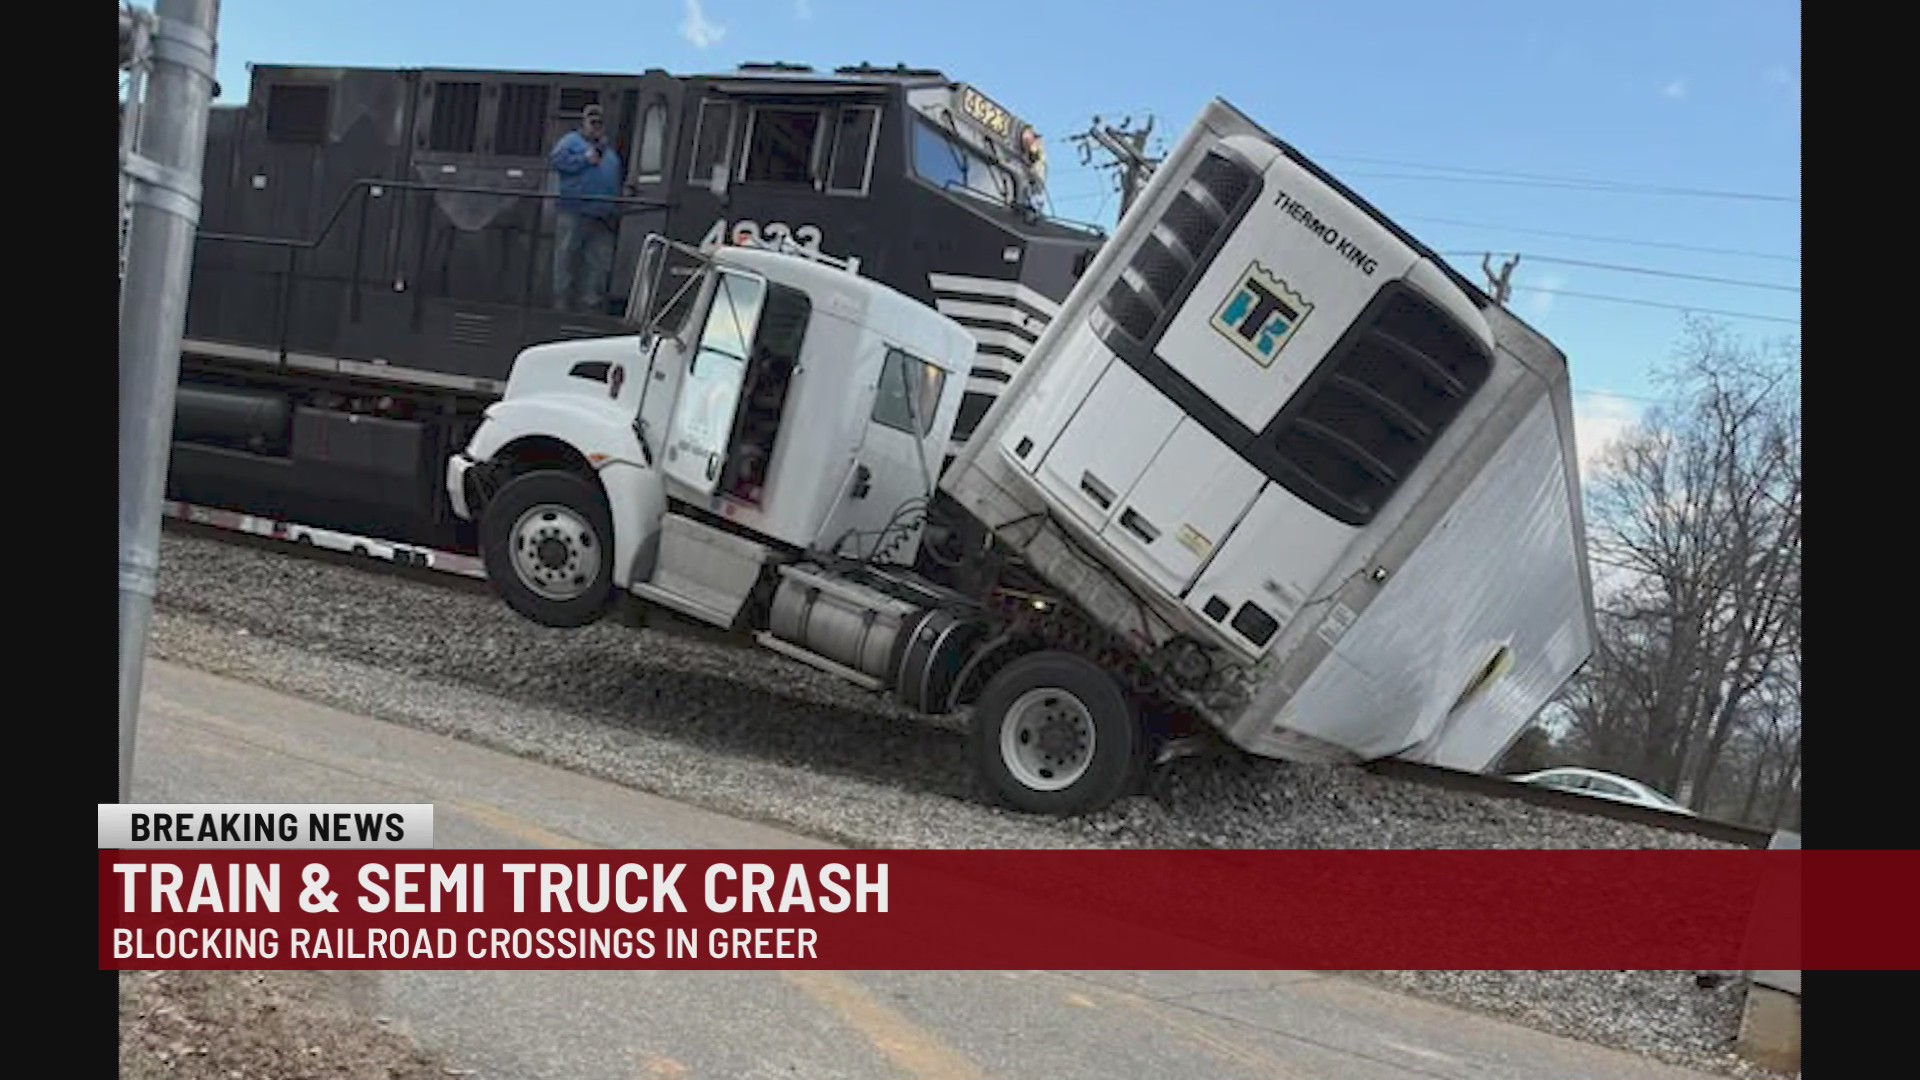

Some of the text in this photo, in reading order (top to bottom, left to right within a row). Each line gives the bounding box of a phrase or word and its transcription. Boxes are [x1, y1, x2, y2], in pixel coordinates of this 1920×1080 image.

[963, 90, 1009, 137] 4923
[1273, 190, 1379, 277] THERMO KING
